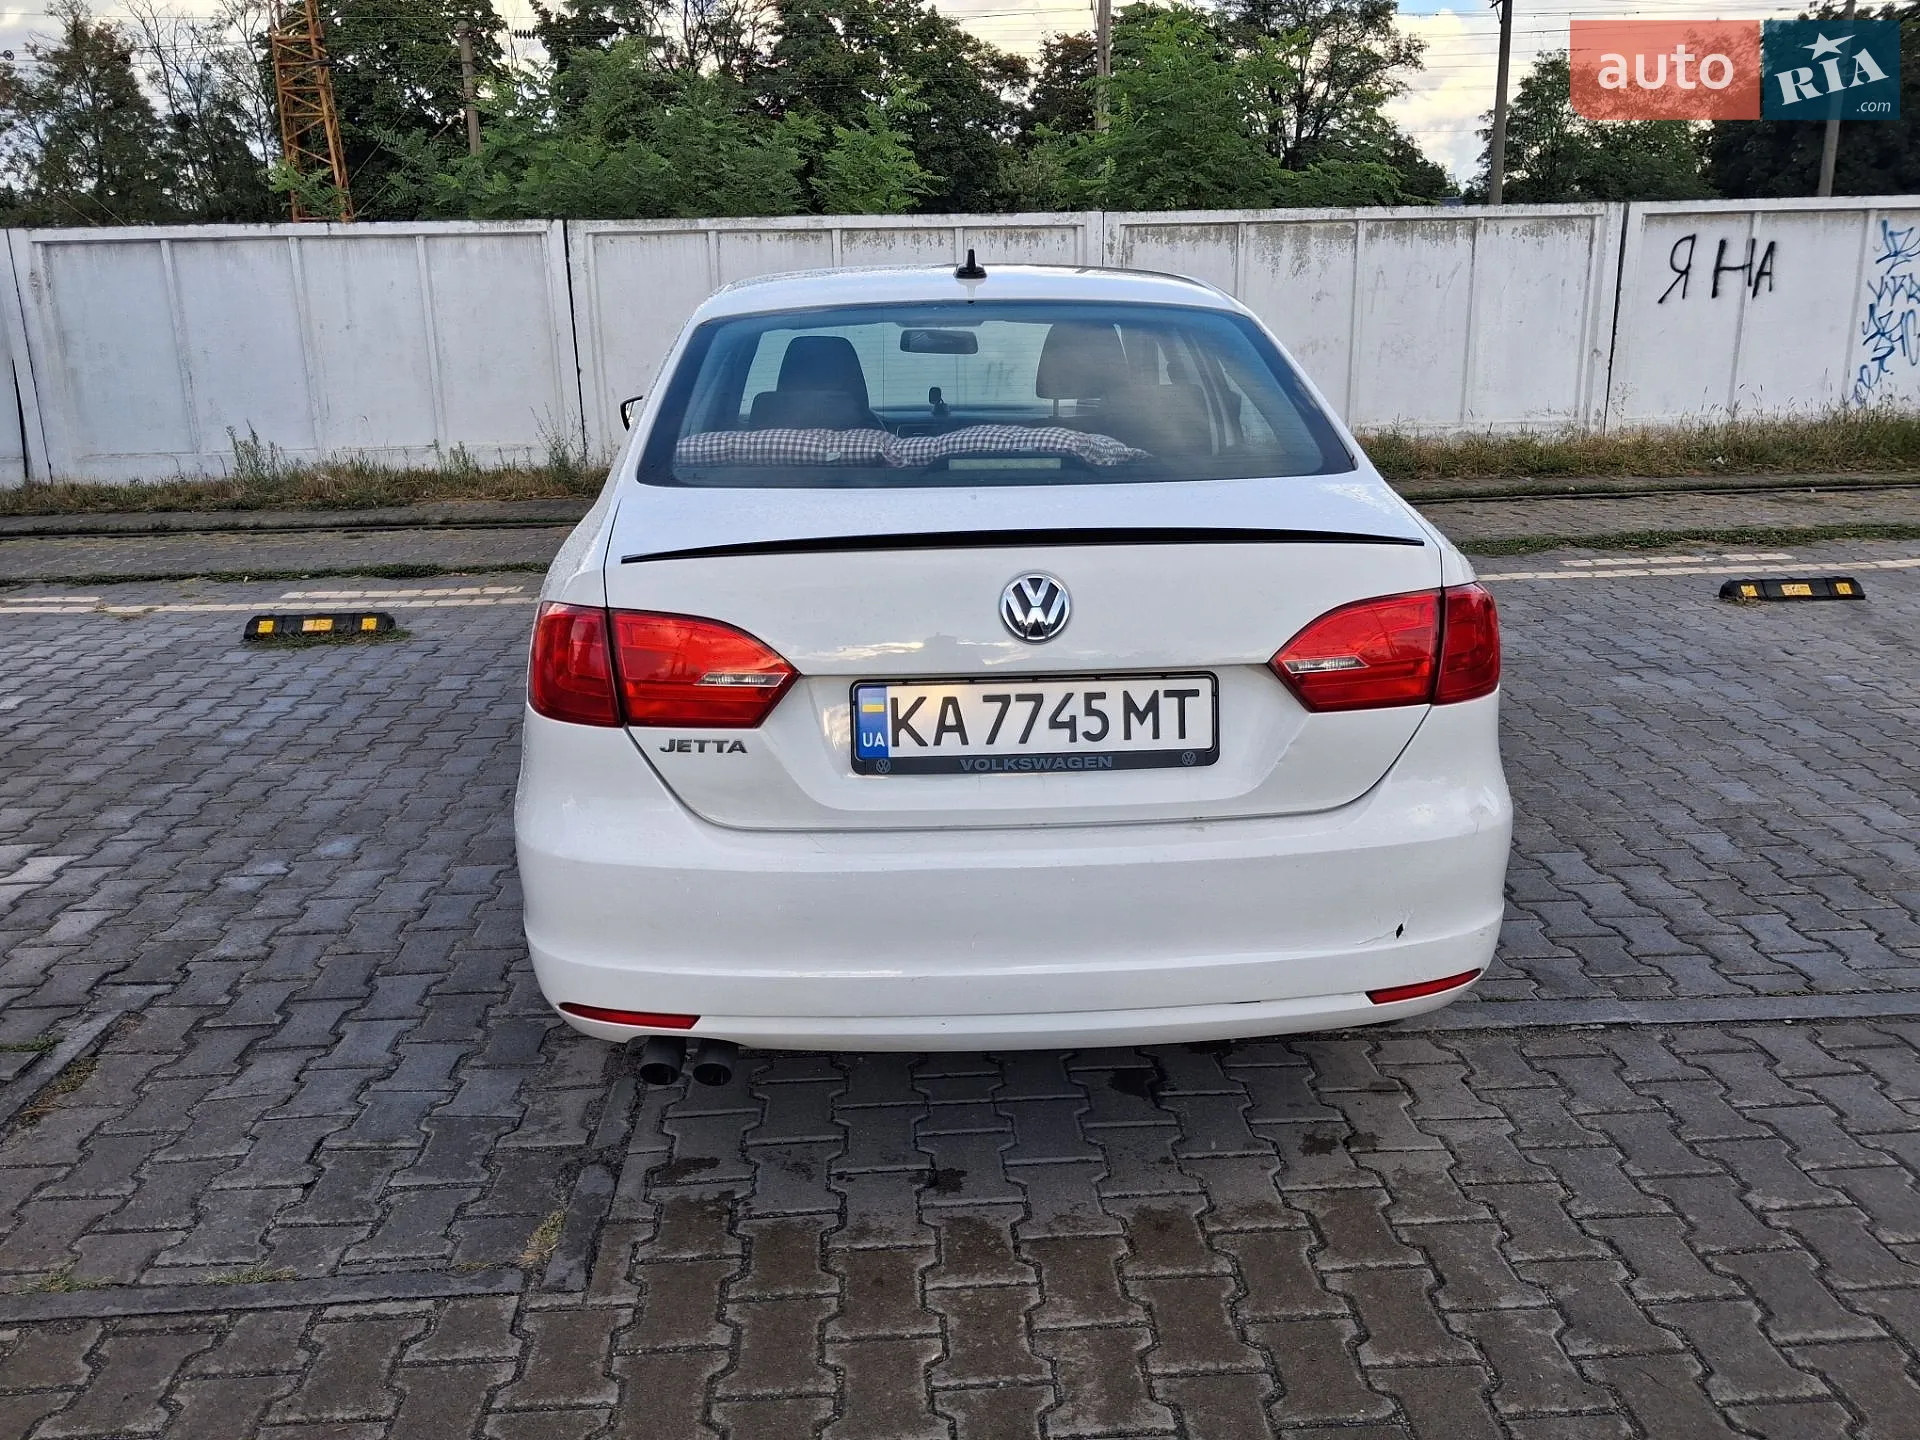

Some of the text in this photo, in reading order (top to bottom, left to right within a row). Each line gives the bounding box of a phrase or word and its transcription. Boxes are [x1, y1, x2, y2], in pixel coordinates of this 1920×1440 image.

[890, 688, 1200, 748] KA 7745 MT
[659, 738, 748, 754] JETTA
[862, 731, 886, 748] UA
[959, 756, 1113, 771] VOLKSWAGEN
